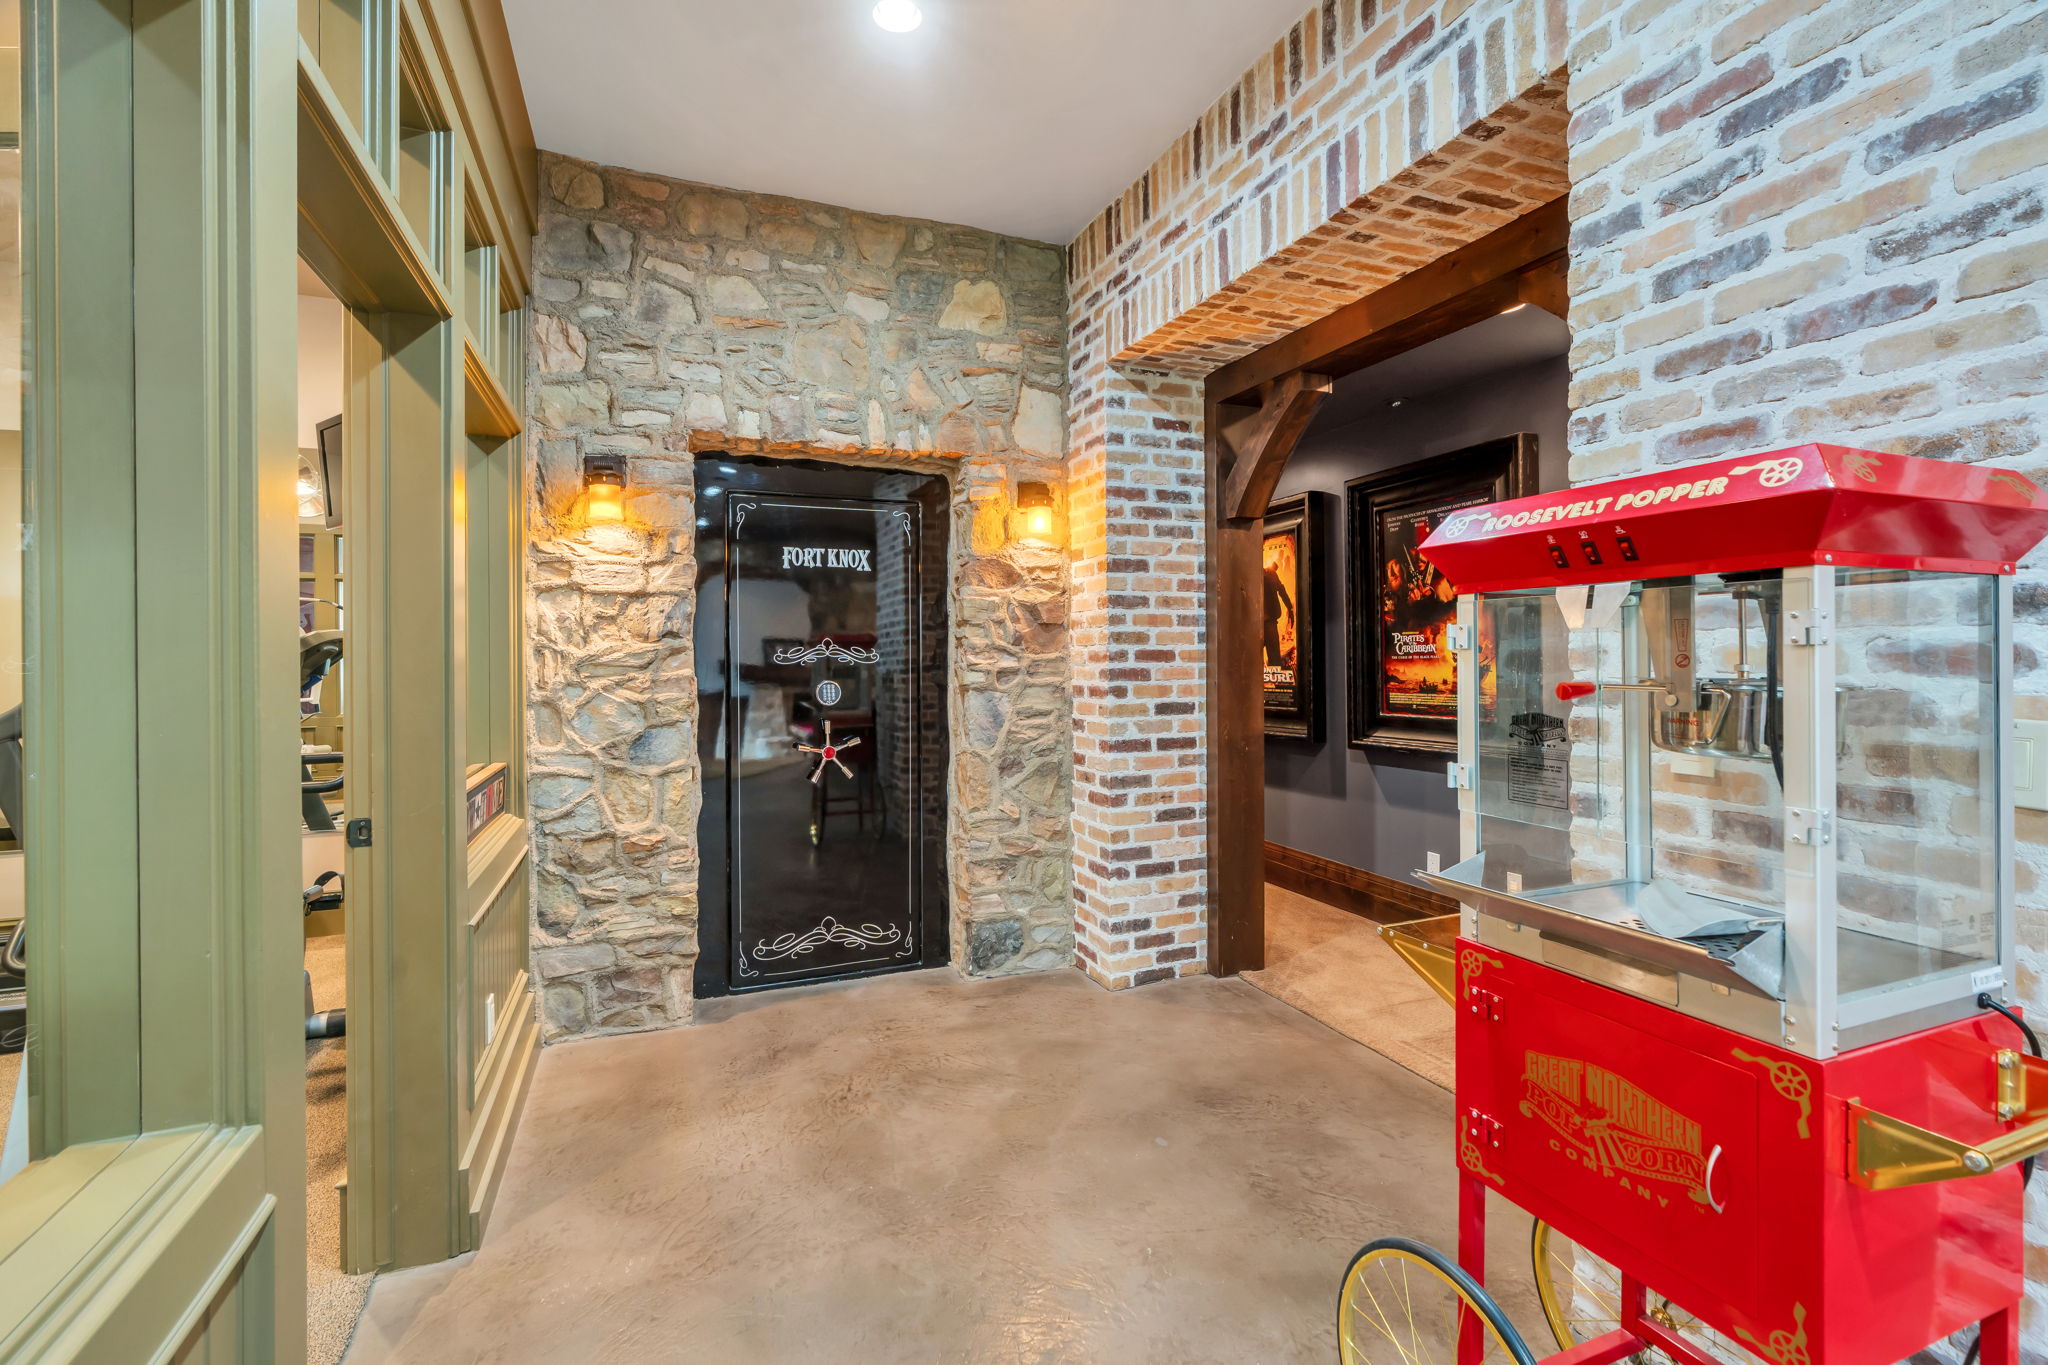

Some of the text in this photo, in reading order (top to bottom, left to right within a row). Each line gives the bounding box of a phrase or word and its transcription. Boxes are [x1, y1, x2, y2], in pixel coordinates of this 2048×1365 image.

[1481, 476, 1729, 534] ROOSEVELT POPPER
[782, 546, 872, 572] FORT KNOX
[1391, 633, 1425, 643] PIRATES
[1396, 642, 1436, 655] CARIBBEAN
[1525, 1050, 1702, 1155] GREAT NORTHERN
[1526, 1080, 1706, 1184] POP CORN
[1549, 1138, 1669, 1208] COMPANY
